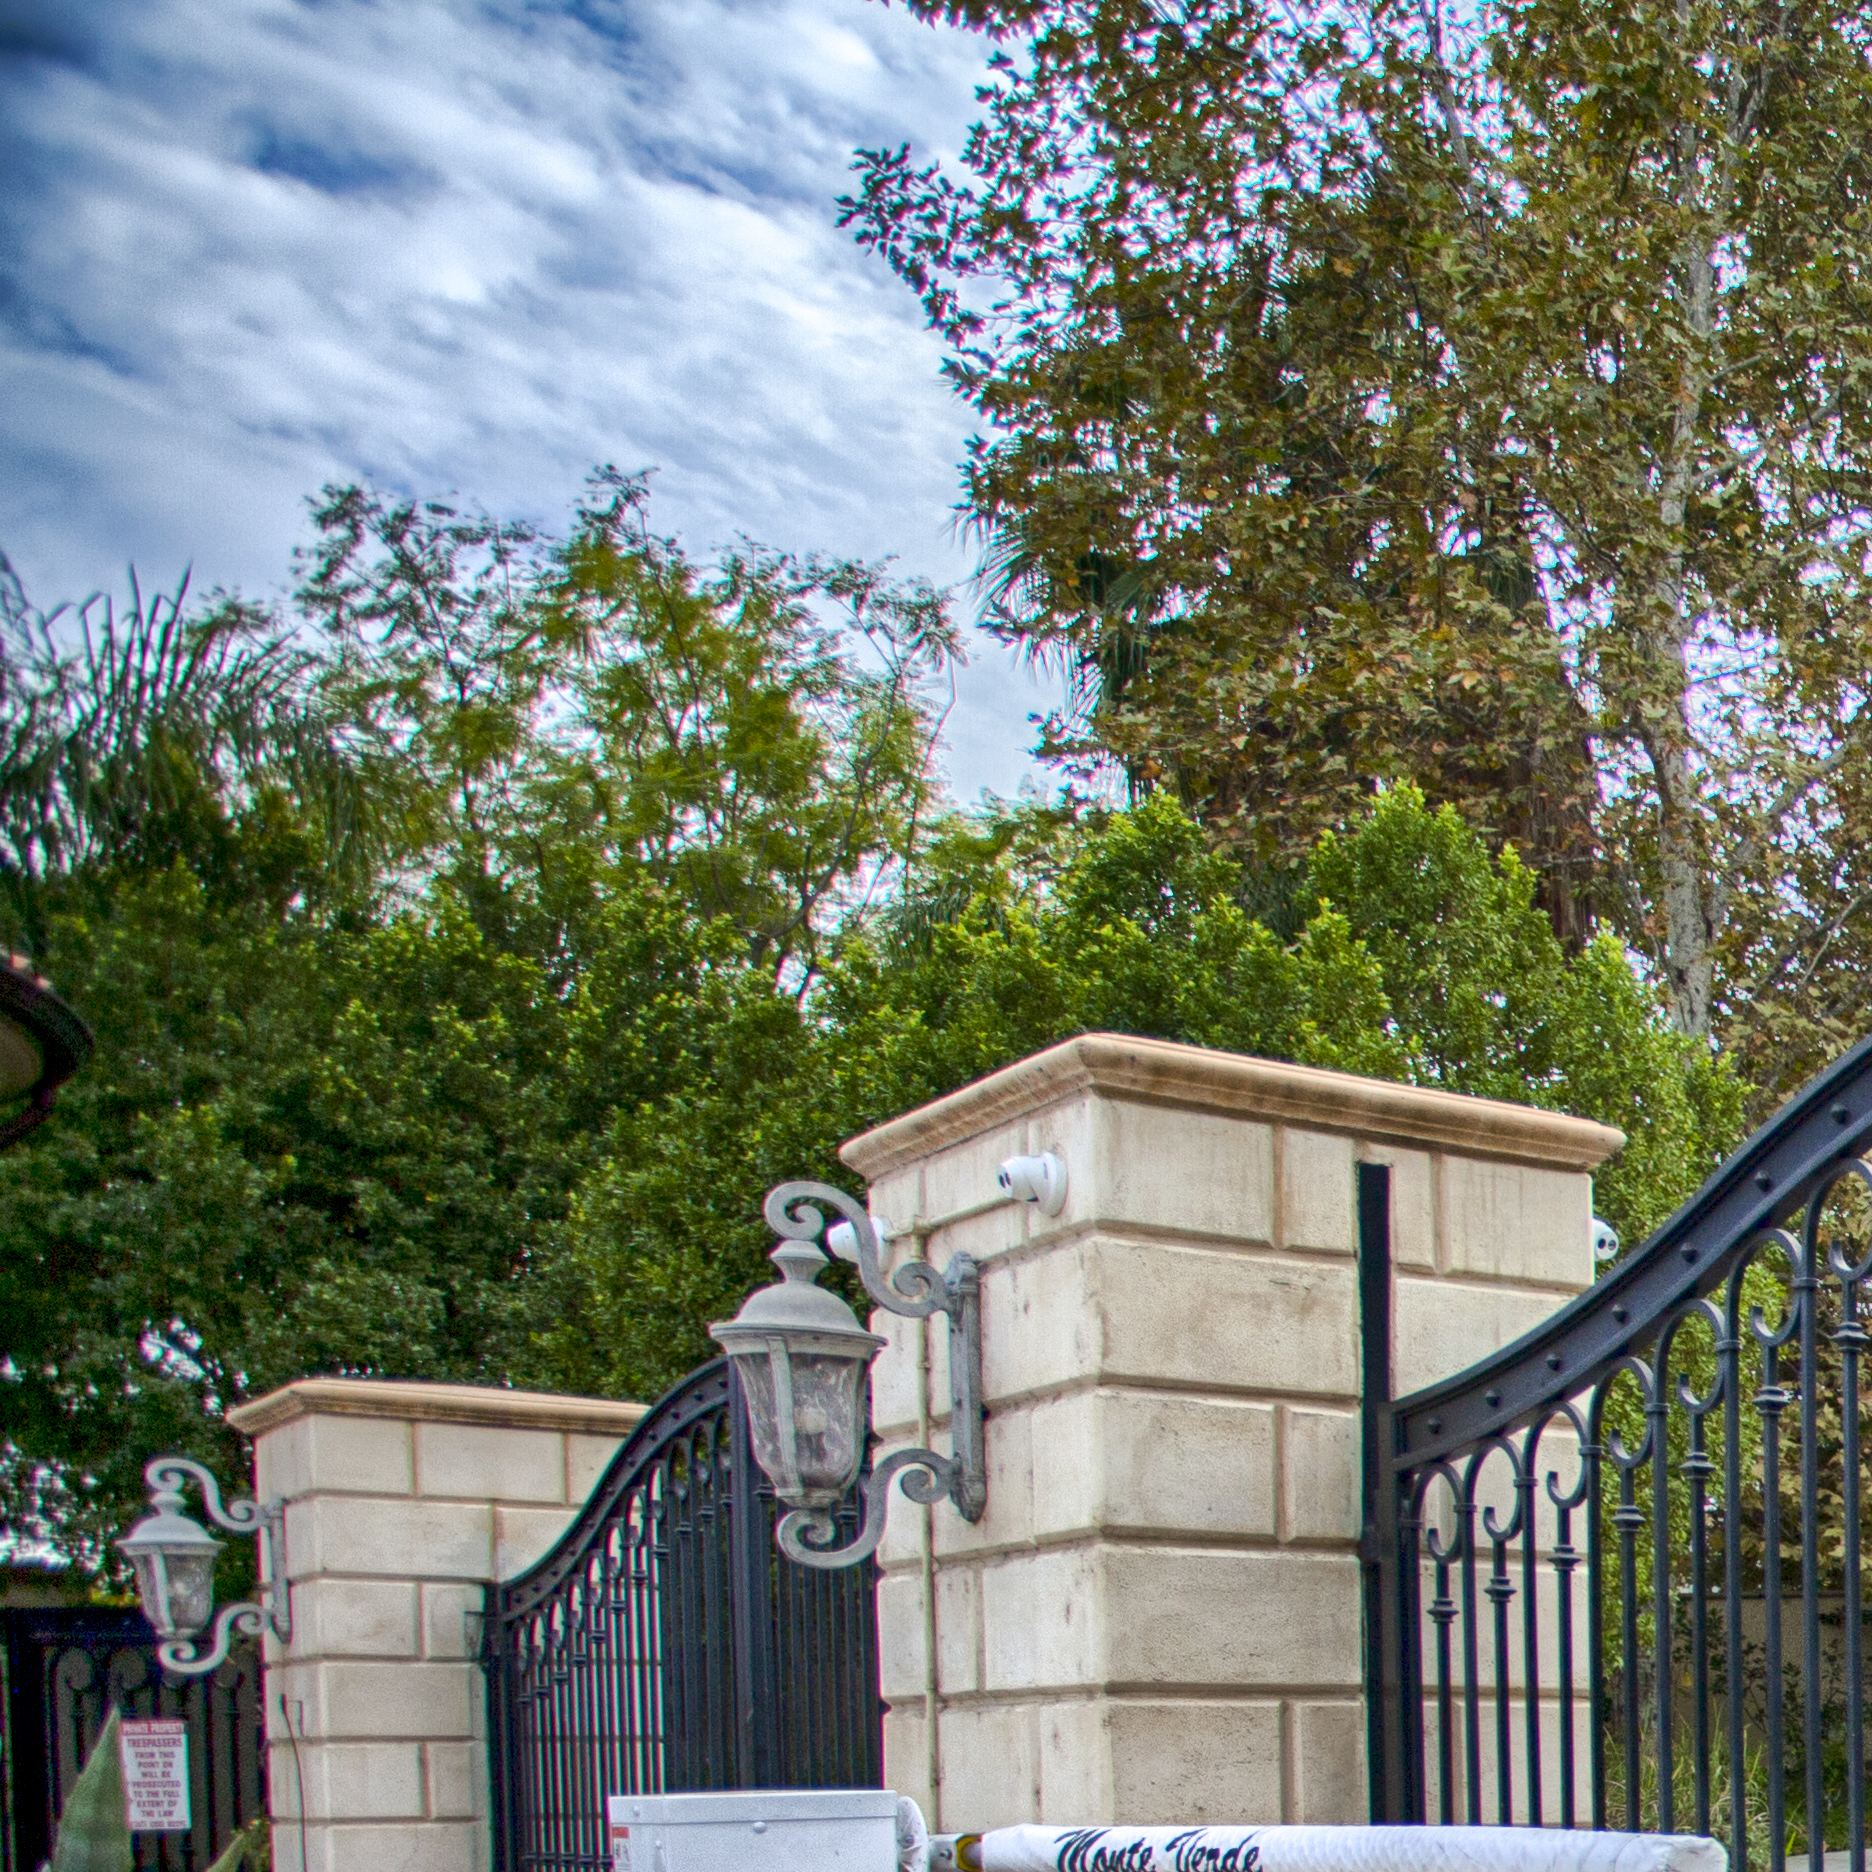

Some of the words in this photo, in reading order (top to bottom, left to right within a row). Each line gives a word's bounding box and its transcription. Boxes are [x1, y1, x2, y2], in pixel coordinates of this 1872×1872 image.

[127, 1738, 183, 1748] TRESPASSERS
[134, 1751, 156, 1759] FROM
[159, 1751, 176, 1759] THIS
[138, 1761, 160, 1769] POINT
[141, 1771, 159, 1779] WILL
[161, 1771, 172, 1779] BE
[132, 1780, 181, 1788] PROSECUTED
[133, 1790, 144, 1798] TO
[146, 1790, 160, 1798] THE
[137, 1800, 165, 1808] EXTENT
[167, 1800, 178, 1808] OF
